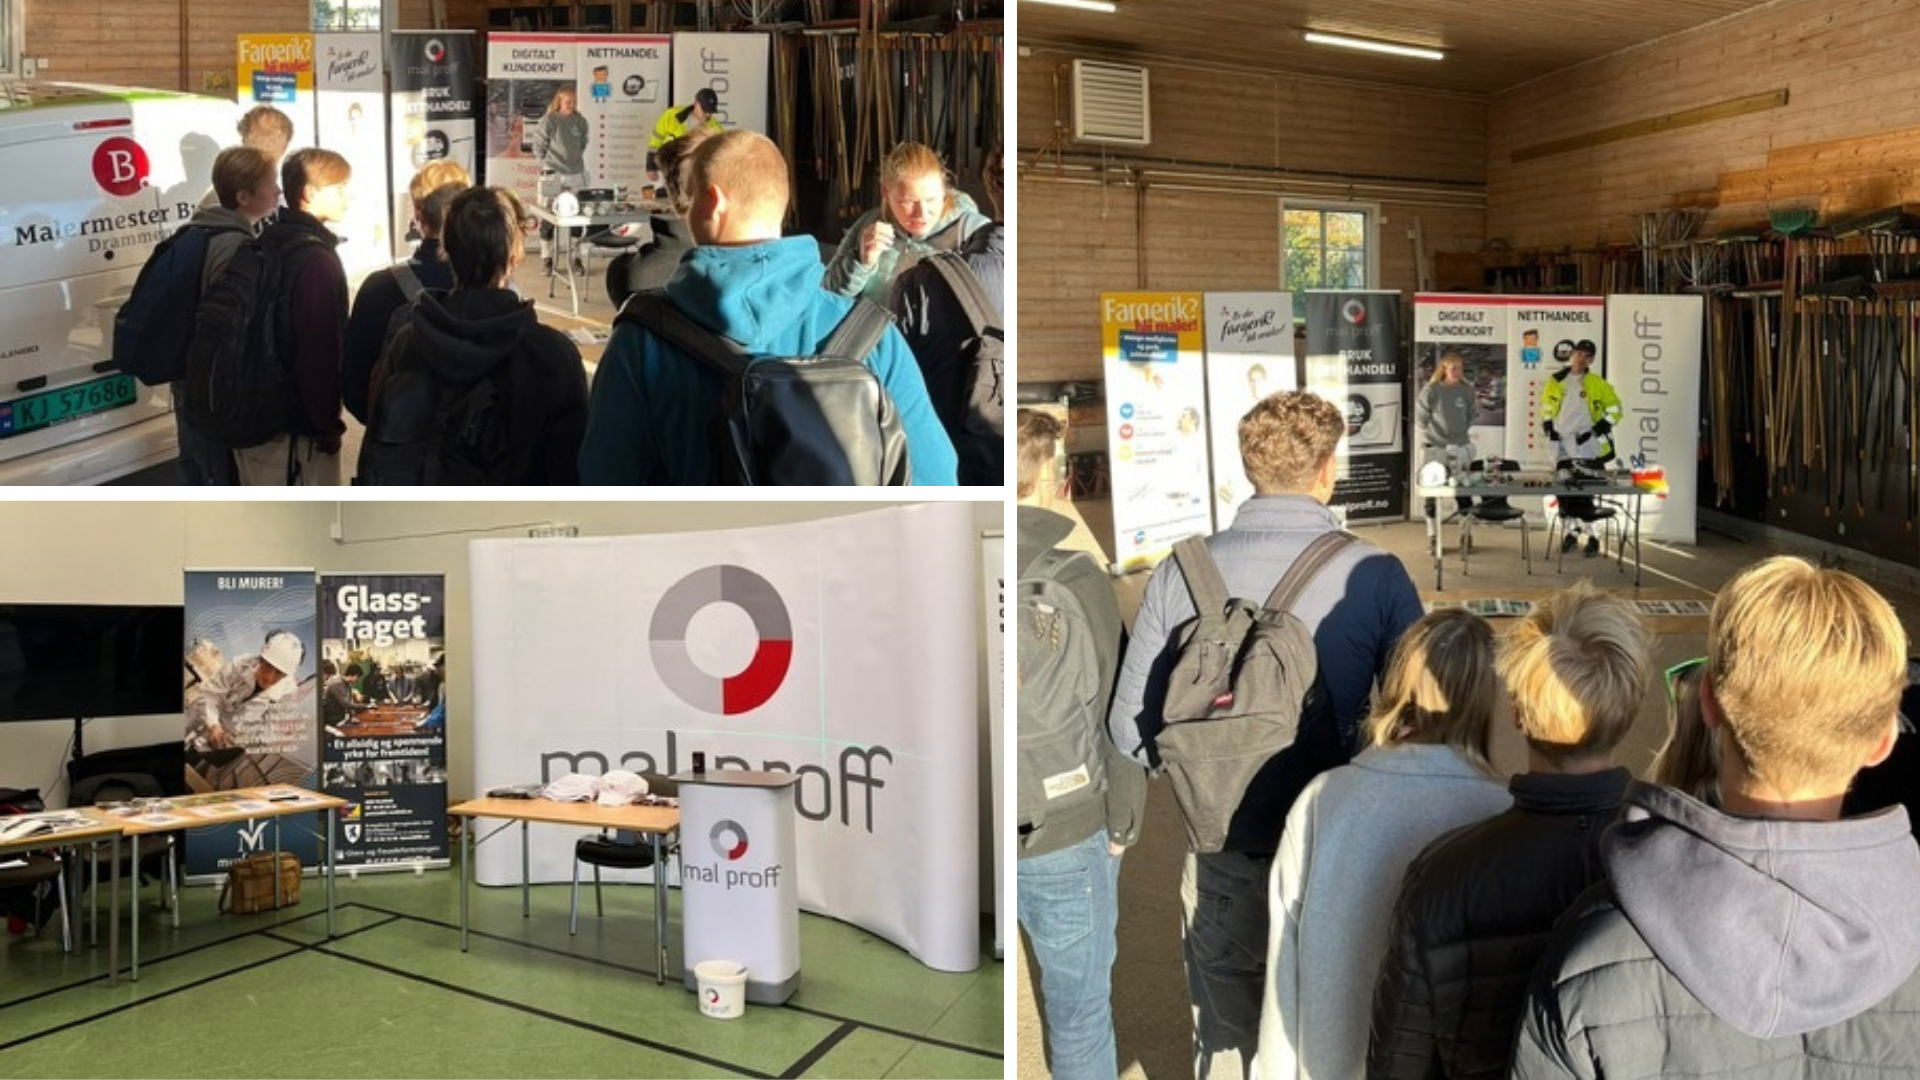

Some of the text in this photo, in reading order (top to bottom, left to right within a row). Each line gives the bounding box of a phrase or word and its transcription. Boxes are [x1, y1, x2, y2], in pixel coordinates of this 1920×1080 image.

[240, 37, 310, 64] Fargerik?
[512, 49, 557, 60] DIGITALT
[587, 47, 659, 60] NETTHANDEL
[502, 63, 565, 74] KUNDEKORT
[15, 205, 170, 246] Malermester
[1105, 296, 1198, 324] Fargerik?
[1438, 310, 1484, 322] DIGITALT
[1517, 310, 1592, 323] NETTHANDEL
[1429, 326, 1493, 337] KUNDEKORT
[1633, 310, 1669, 395] proff
[21, 398, 48, 423] KJ
[60, 379, 128, 415] 57686
[1632, 408, 1660, 464] mal
[217, 577, 284, 590] BLI MURER!
[337, 585, 432, 613] Glass-
[343, 612, 427, 647] faget
[683, 863, 782, 890] mal proff
